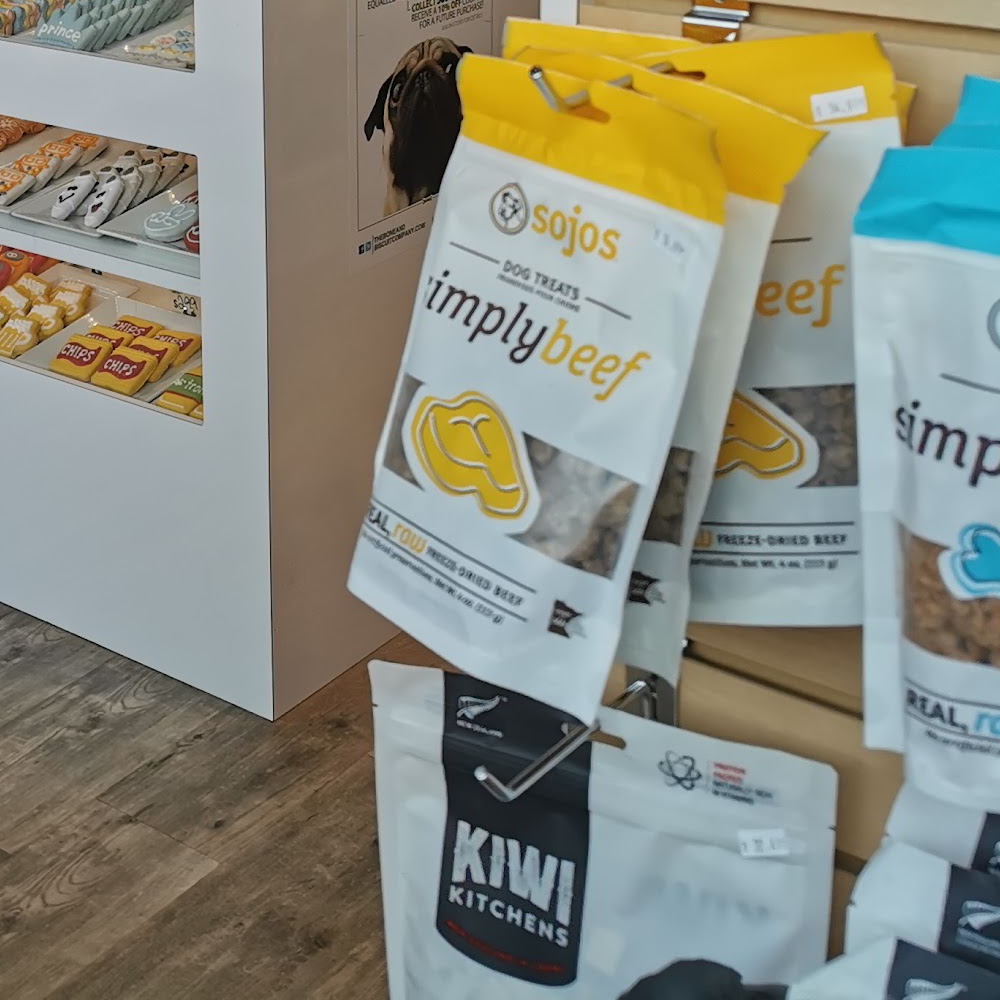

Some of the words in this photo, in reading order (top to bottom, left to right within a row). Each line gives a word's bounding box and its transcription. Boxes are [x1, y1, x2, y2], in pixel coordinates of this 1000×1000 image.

[411, 8, 432, 22] RECEIVE
[438, 2, 450, 13] 10%
[451, 0, 461, 9] OFF
[419, 19, 431, 29] FOR
[436, 12, 455, 23] FUTURE
[38, 20, 82, 43] prince
[531, 204, 621, 260] sojos
[502, 261, 530, 281] DOG
[534, 271, 580, 301] TREATS
[111, 321, 145, 337] CHIPS
[60, 343, 95, 362] CHIPS
[103, 358, 137, 376] CHIPS
[367, 507, 390, 536] EAL,
[392, 522, 428, 556] raw
[717, 533, 810, 546] FREEZE-DRIED
[813, 533, 847, 546] BEEF
[906, 687, 968, 733] REAL,
[451, 819, 576, 926] KIWI
[448, 884, 570, 948] KITCHENS
